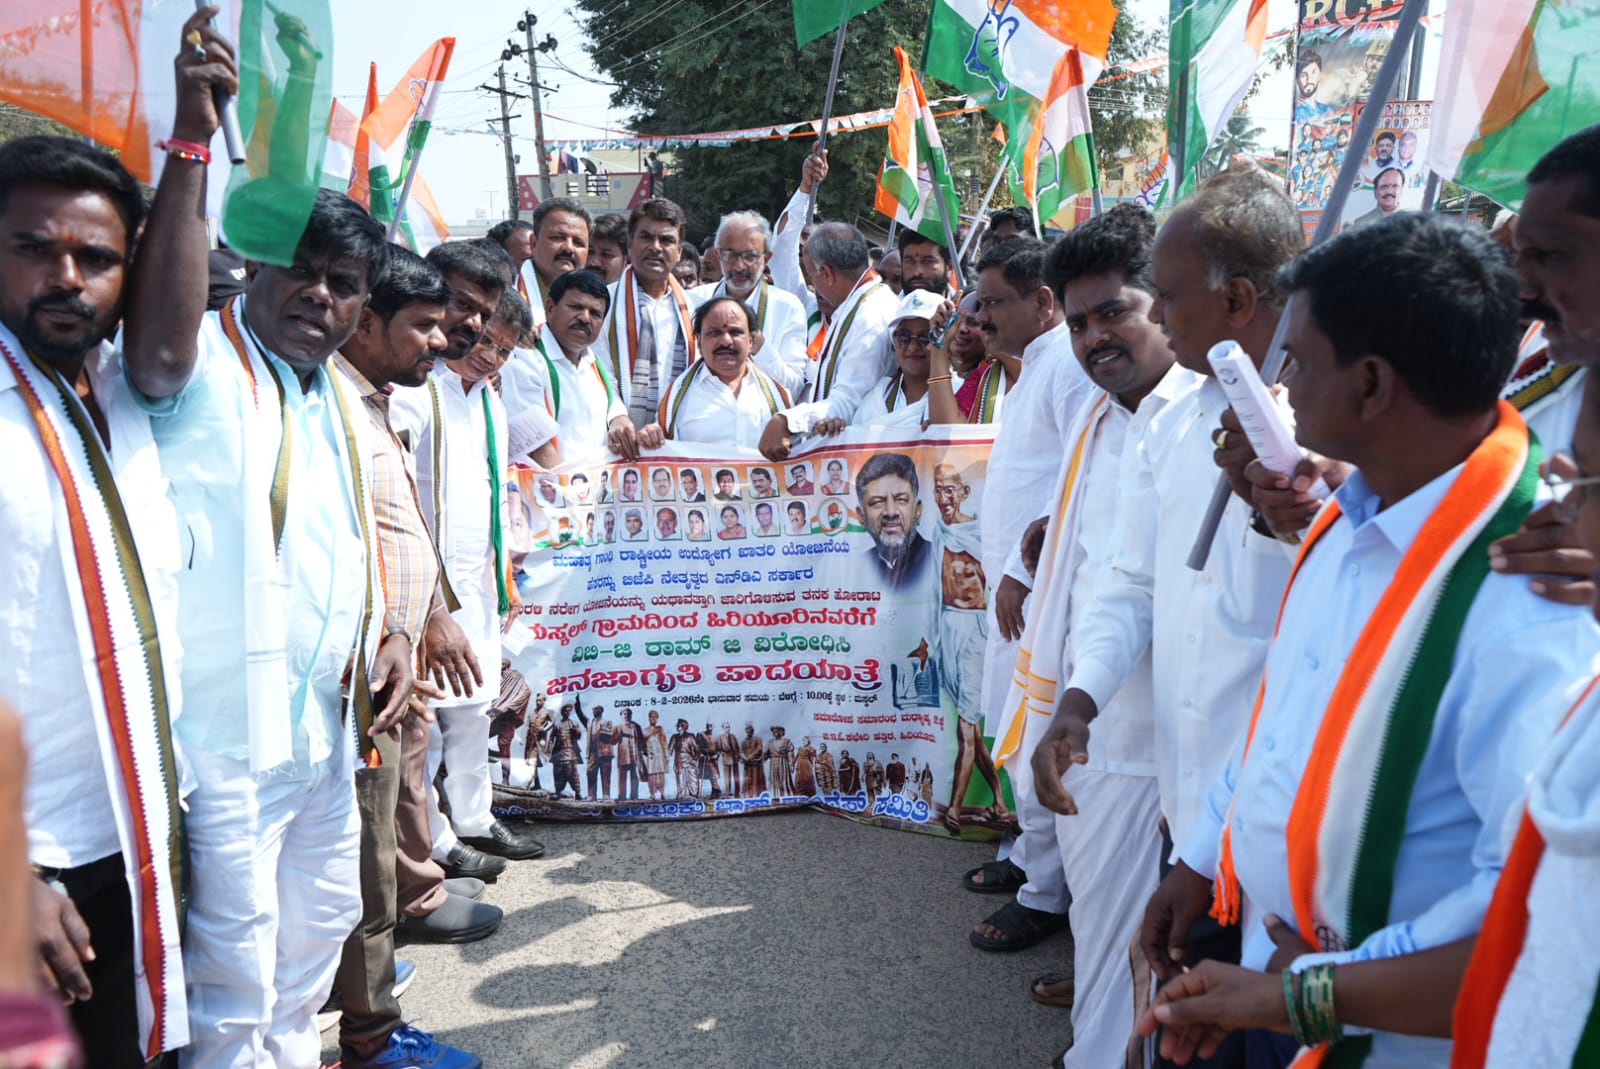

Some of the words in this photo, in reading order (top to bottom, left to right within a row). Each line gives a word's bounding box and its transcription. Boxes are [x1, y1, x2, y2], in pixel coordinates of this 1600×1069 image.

[553, 554, 592, 571] ಮಹಾತ್ಮ
[595, 550, 613, 564] ಗಾಂಧಿ
[620, 547, 672, 569] ರಾಷ್ಟ್ರೀಯ
[679, 546, 731, 567] ಉದ್ಯೋಗ
[738, 544, 775, 558] ಖಾತರಿ
[782, 539, 850, 556] ಯೋಜನೆಯ
[622, 571, 654, 586] ಬಿಜೆಪಿ
[661, 570, 709, 590] ನೇತೃತ್ವದ
[768, 566, 814, 582] ಸರ್ಕಾರ
[583, 595, 646, 612] ಯೋಜನೆಯನ್ನು
[651, 593, 716, 608] ಯಥಾವತ್ತಾಗಿ
[720, 591, 796, 606] ಜಾರಿಗೊಳಿಸುವ
[802, 588, 829, 601] ತನಕ
[834, 589, 881, 602] ಹೋರಾಟ
[592, 611, 698, 638] ಗ್ರಾಮದಿಂದ
[706, 606, 877, 627] ಹಿರಿಯೂರಿನವರೆಗೆ
[645, 635, 711, 656] ರಾಮ್
[724, 638, 741, 653] ಜಿ
[754, 631, 851, 654] ವಿರೋಧಿಸಿ
[546, 663, 702, 695] ಜನಜಾಗೃತಿ
[716, 658, 882, 690] ಪಾದಯಾತ್ರೆ
[650, 694, 704, 706] 8-2-2026ನೇ
[874, 793, 929, 822] ಸಮಿತಿ
